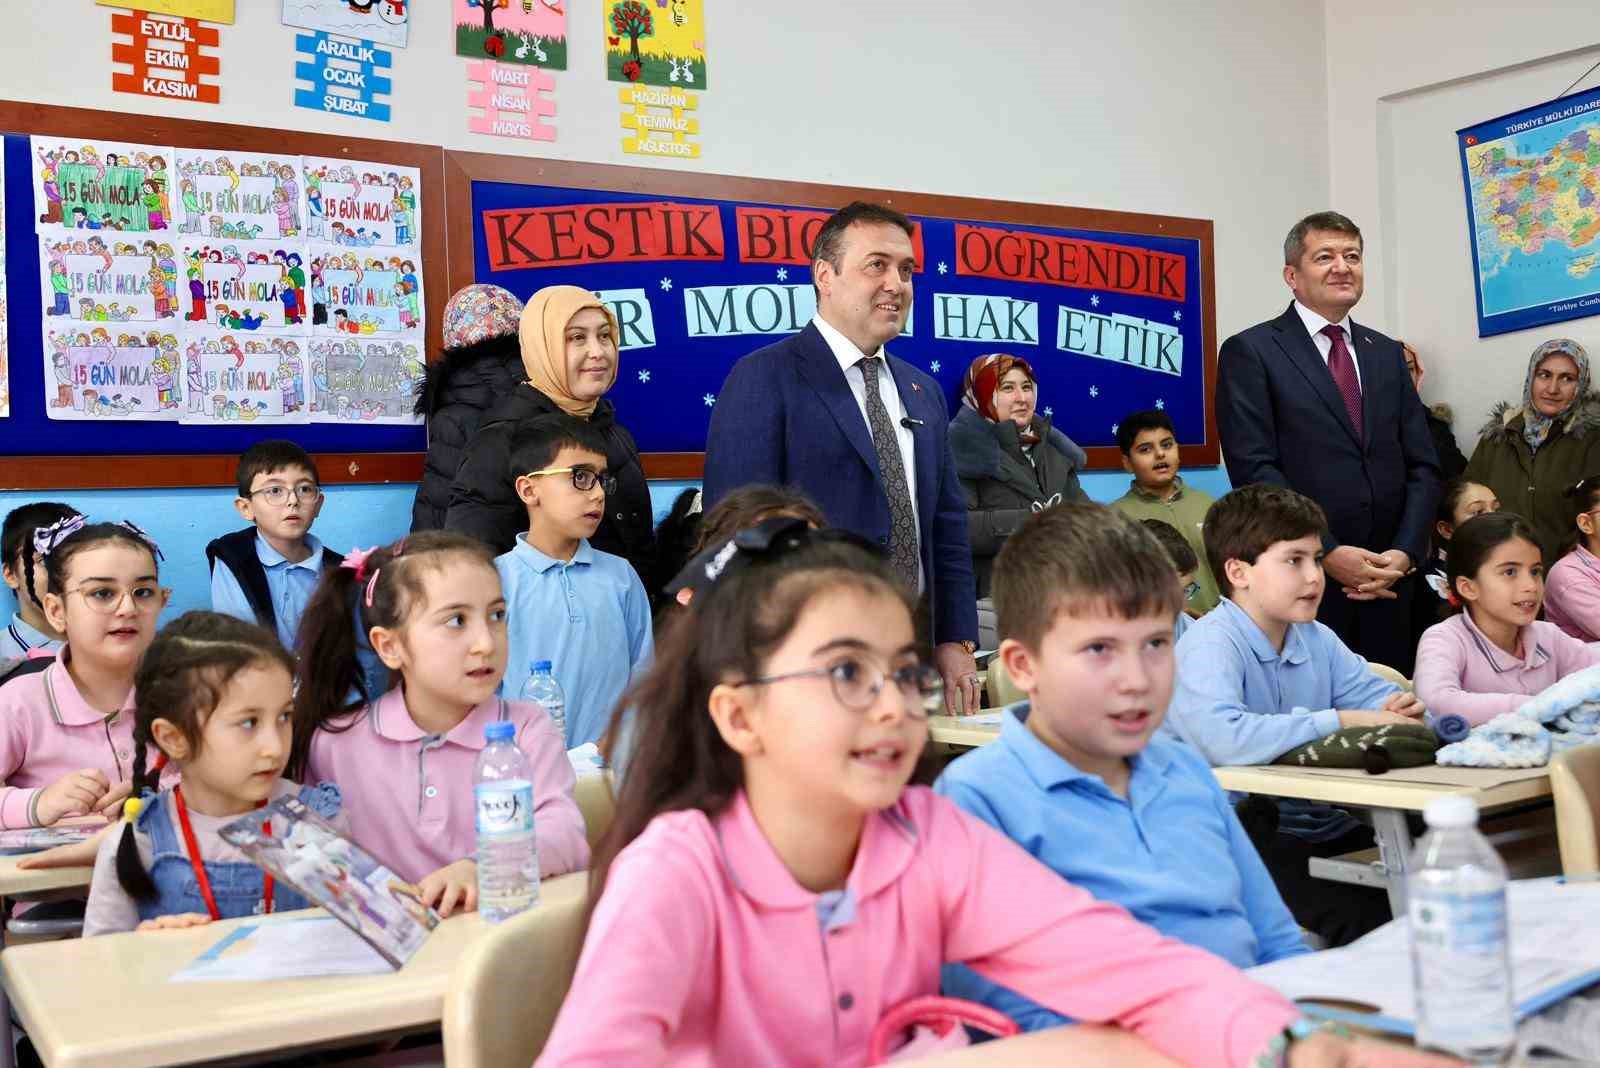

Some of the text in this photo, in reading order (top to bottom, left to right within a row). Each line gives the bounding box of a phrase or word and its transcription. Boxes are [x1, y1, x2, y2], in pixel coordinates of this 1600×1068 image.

[141, 20, 195, 42] EYLÜL
[145, 47, 189, 69] EKİM
[317, 40, 375, 63] ARALIK
[143, 78, 197, 98] KASIM
[323, 68, 365, 87] OCAK
[491, 69, 529, 84] MART
[323, 96, 368, 115] ŞUBAT
[492, 93, 530, 111] NİSAN
[493, 121, 531, 136] MAYIS
[637, 116, 688, 130] TEMMUZ
[1506, 116, 1543, 134] TÜRKİYE
[63, 180, 140, 206] 15 GÜN MOLA
[199, 188, 272, 214] 15 GÜN MOLA
[325, 197, 389, 222] 15 GÜN MOLA
[490, 202, 722, 265] KESTİK
[961, 224, 1182, 298] ÖĞRENDİK
[71, 269, 147, 296] 15 GÜN MOLA
[207, 278, 277, 302] 15 GÜN MOLA
[327, 283, 395, 307] 15 GÜN MOLA
[938, 296, 1036, 342] HAK
[1062, 309, 1180, 373] ETTİK
[74, 361, 151, 386] 15 GÜN MOLA
[204, 367, 277, 392] 15 GÜN MOLA
